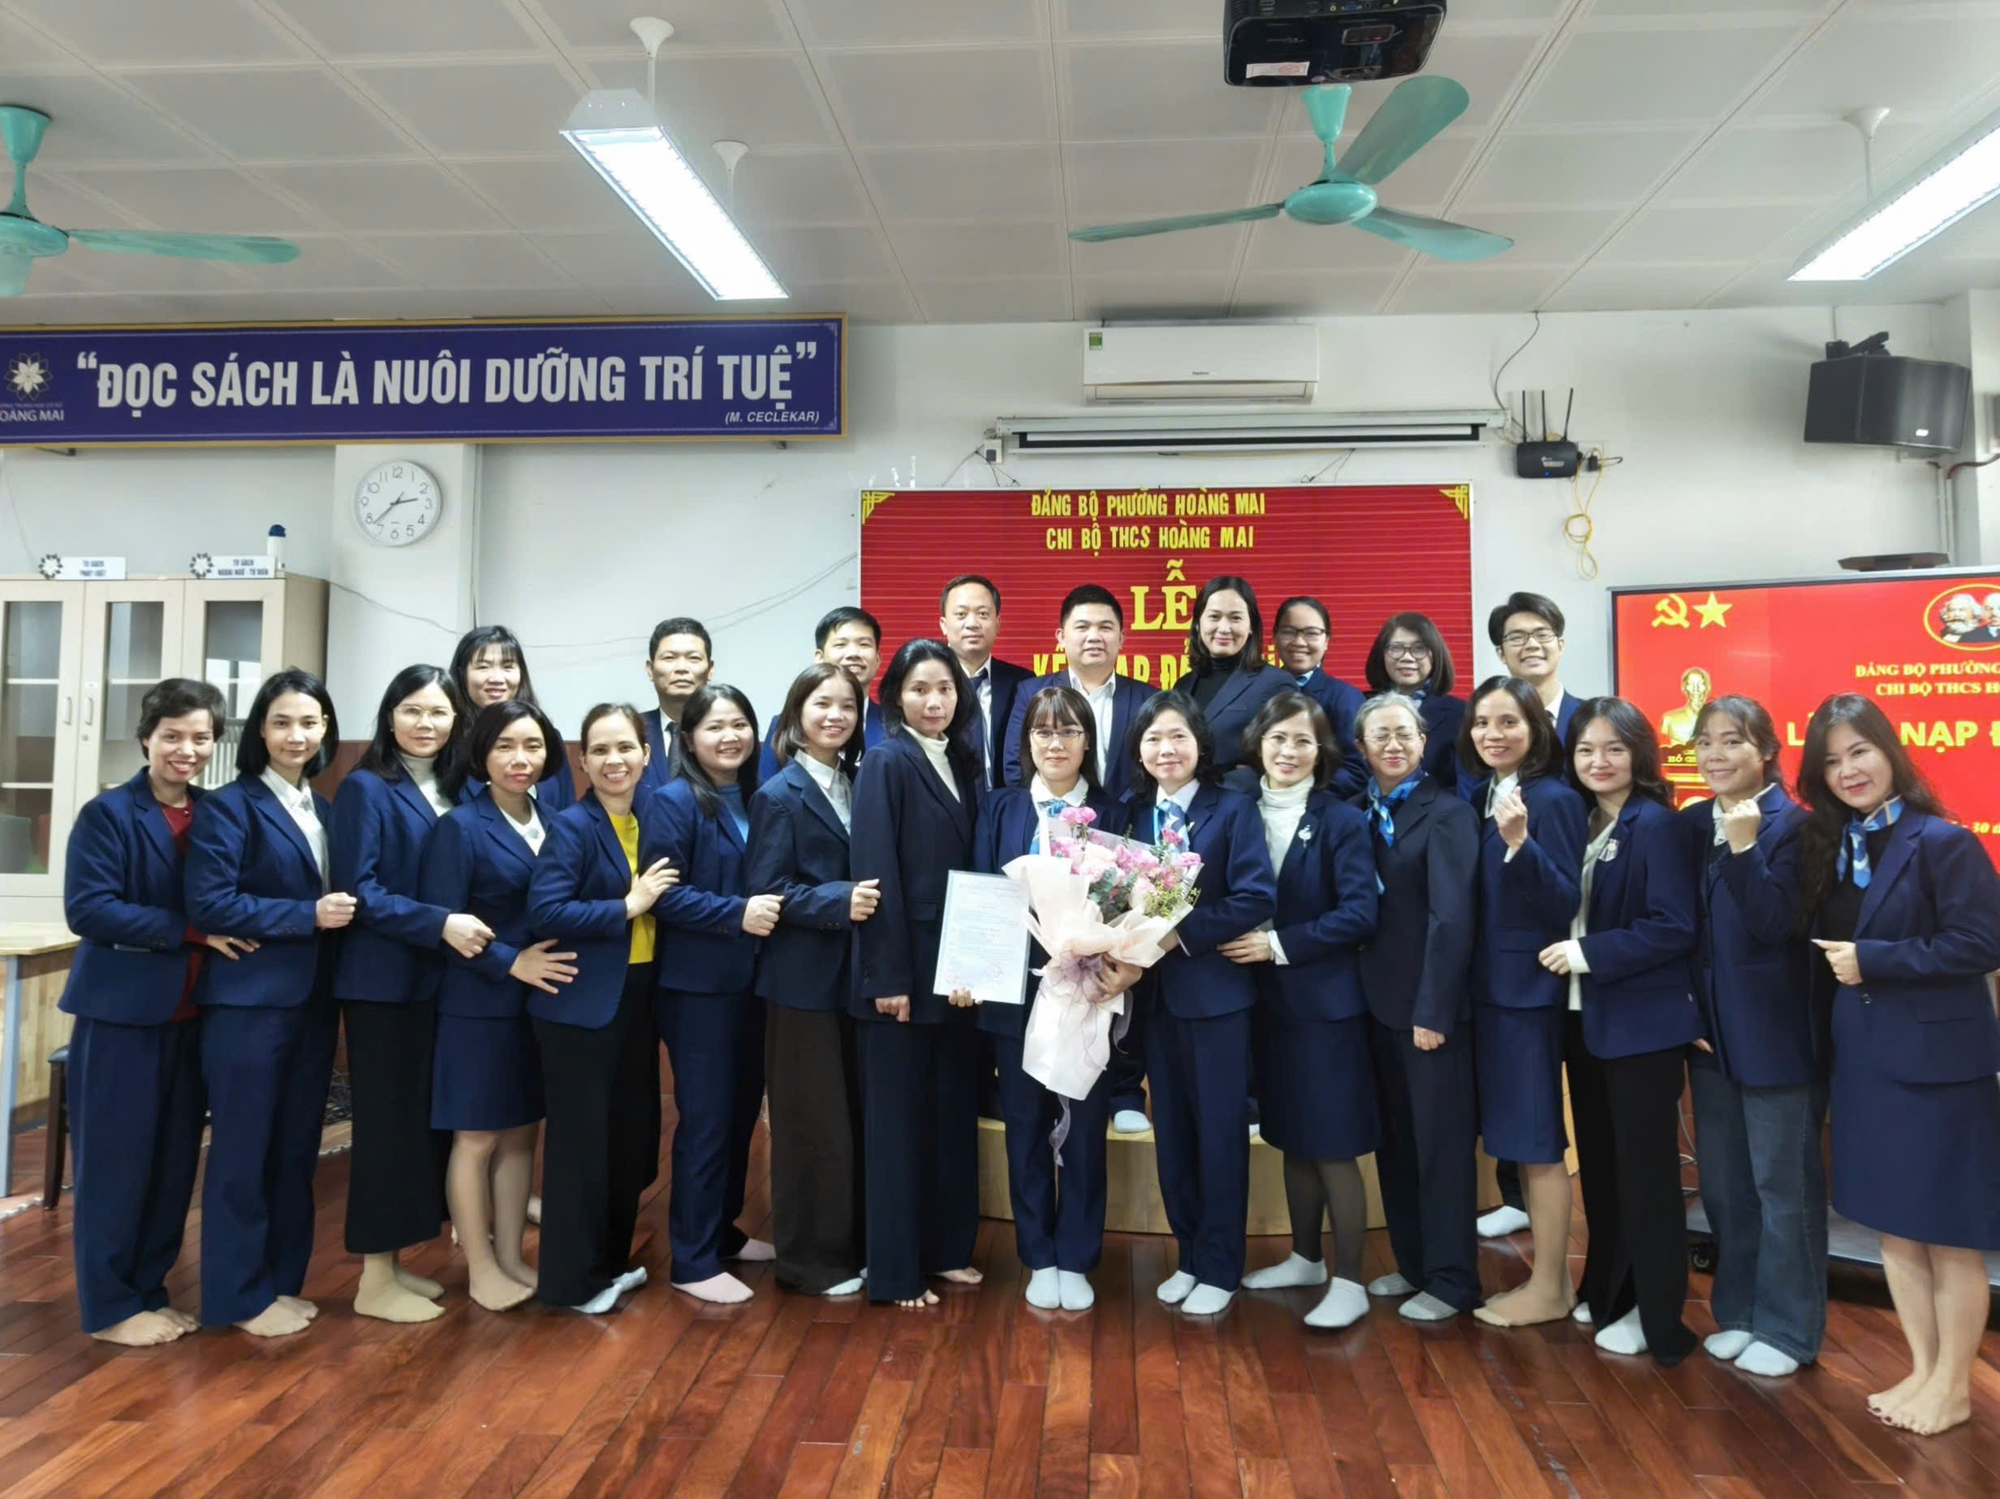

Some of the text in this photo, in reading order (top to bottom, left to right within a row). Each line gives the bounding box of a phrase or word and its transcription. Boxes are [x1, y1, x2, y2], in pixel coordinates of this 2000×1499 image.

[190, 352, 298, 407] SÁCH
[311, 351, 360, 406] LÀ
[372, 350, 471, 405] NUÔI
[485, 347, 626, 403] DƯỠNG
[640, 345, 705, 401] TRÍ
[39, 409, 65, 421] MAI
[725, 411, 819, 425] (M. CECLEKAR)
[1031, 487, 1265, 522] ĐẢNG BỘ PHƯỜNG HOÀNG MAI
[1046, 519, 1254, 557] CHI BỘ THCS HOÀNG MAI
[1130, 559, 1197, 631] LỄ
[1855, 661, 1899, 678] ĐẢNG
[1903, 662, 1926, 678] BỘ
[1876, 682, 1905, 696] CHI
[1909, 681, 1932, 697] BỘ
[1934, 682, 1981, 694] THCS
[1900, 720, 1978, 753] NẠP
